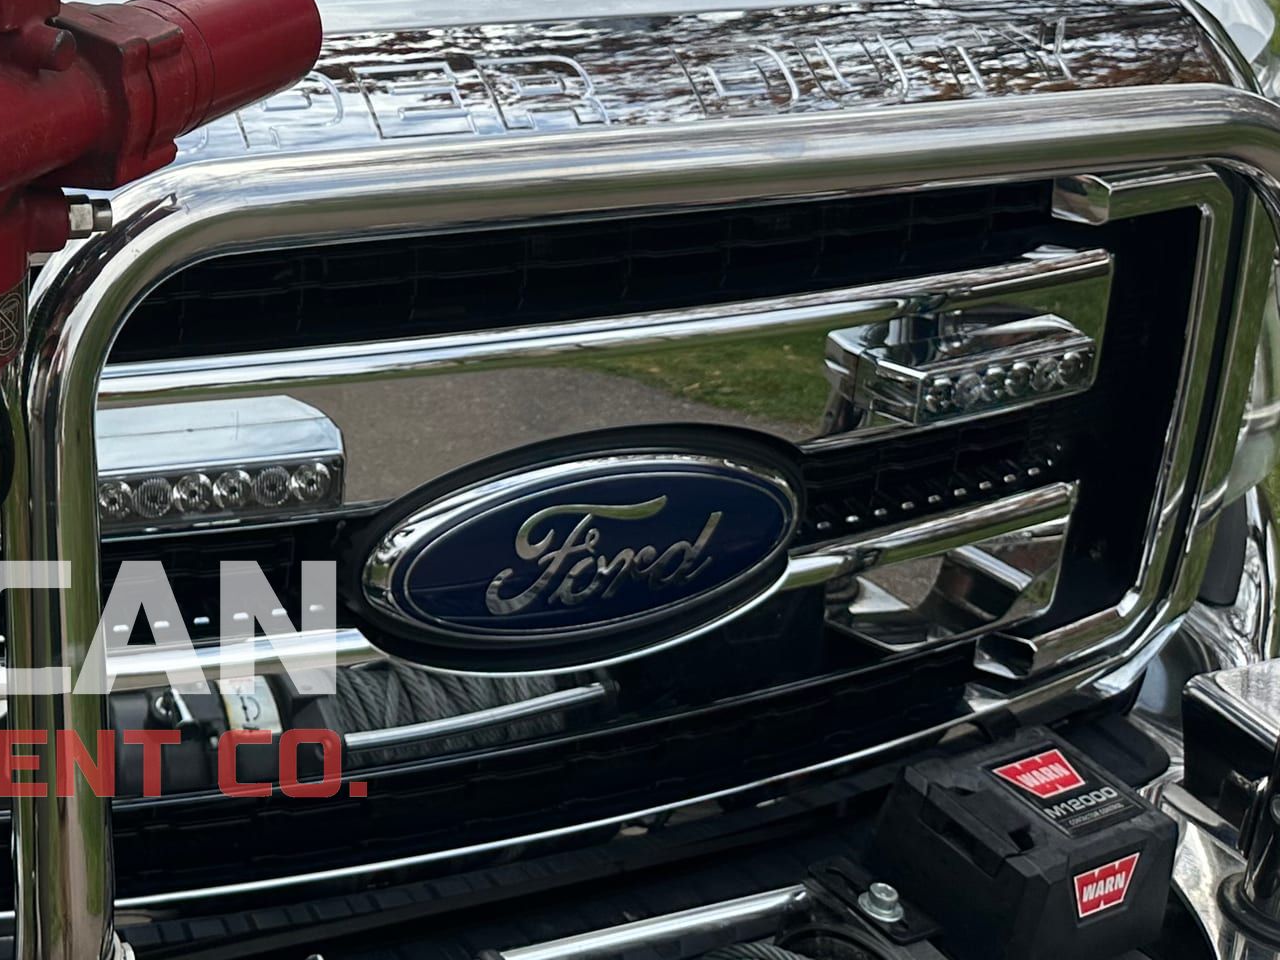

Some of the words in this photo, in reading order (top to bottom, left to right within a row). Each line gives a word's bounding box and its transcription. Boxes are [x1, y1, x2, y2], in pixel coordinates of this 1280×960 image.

[485, 495, 723, 616] Ford
[1016, 762, 1071, 788] WARN
[1044, 786, 1118, 819] M12000
[1082, 871, 1126, 903] WARN
